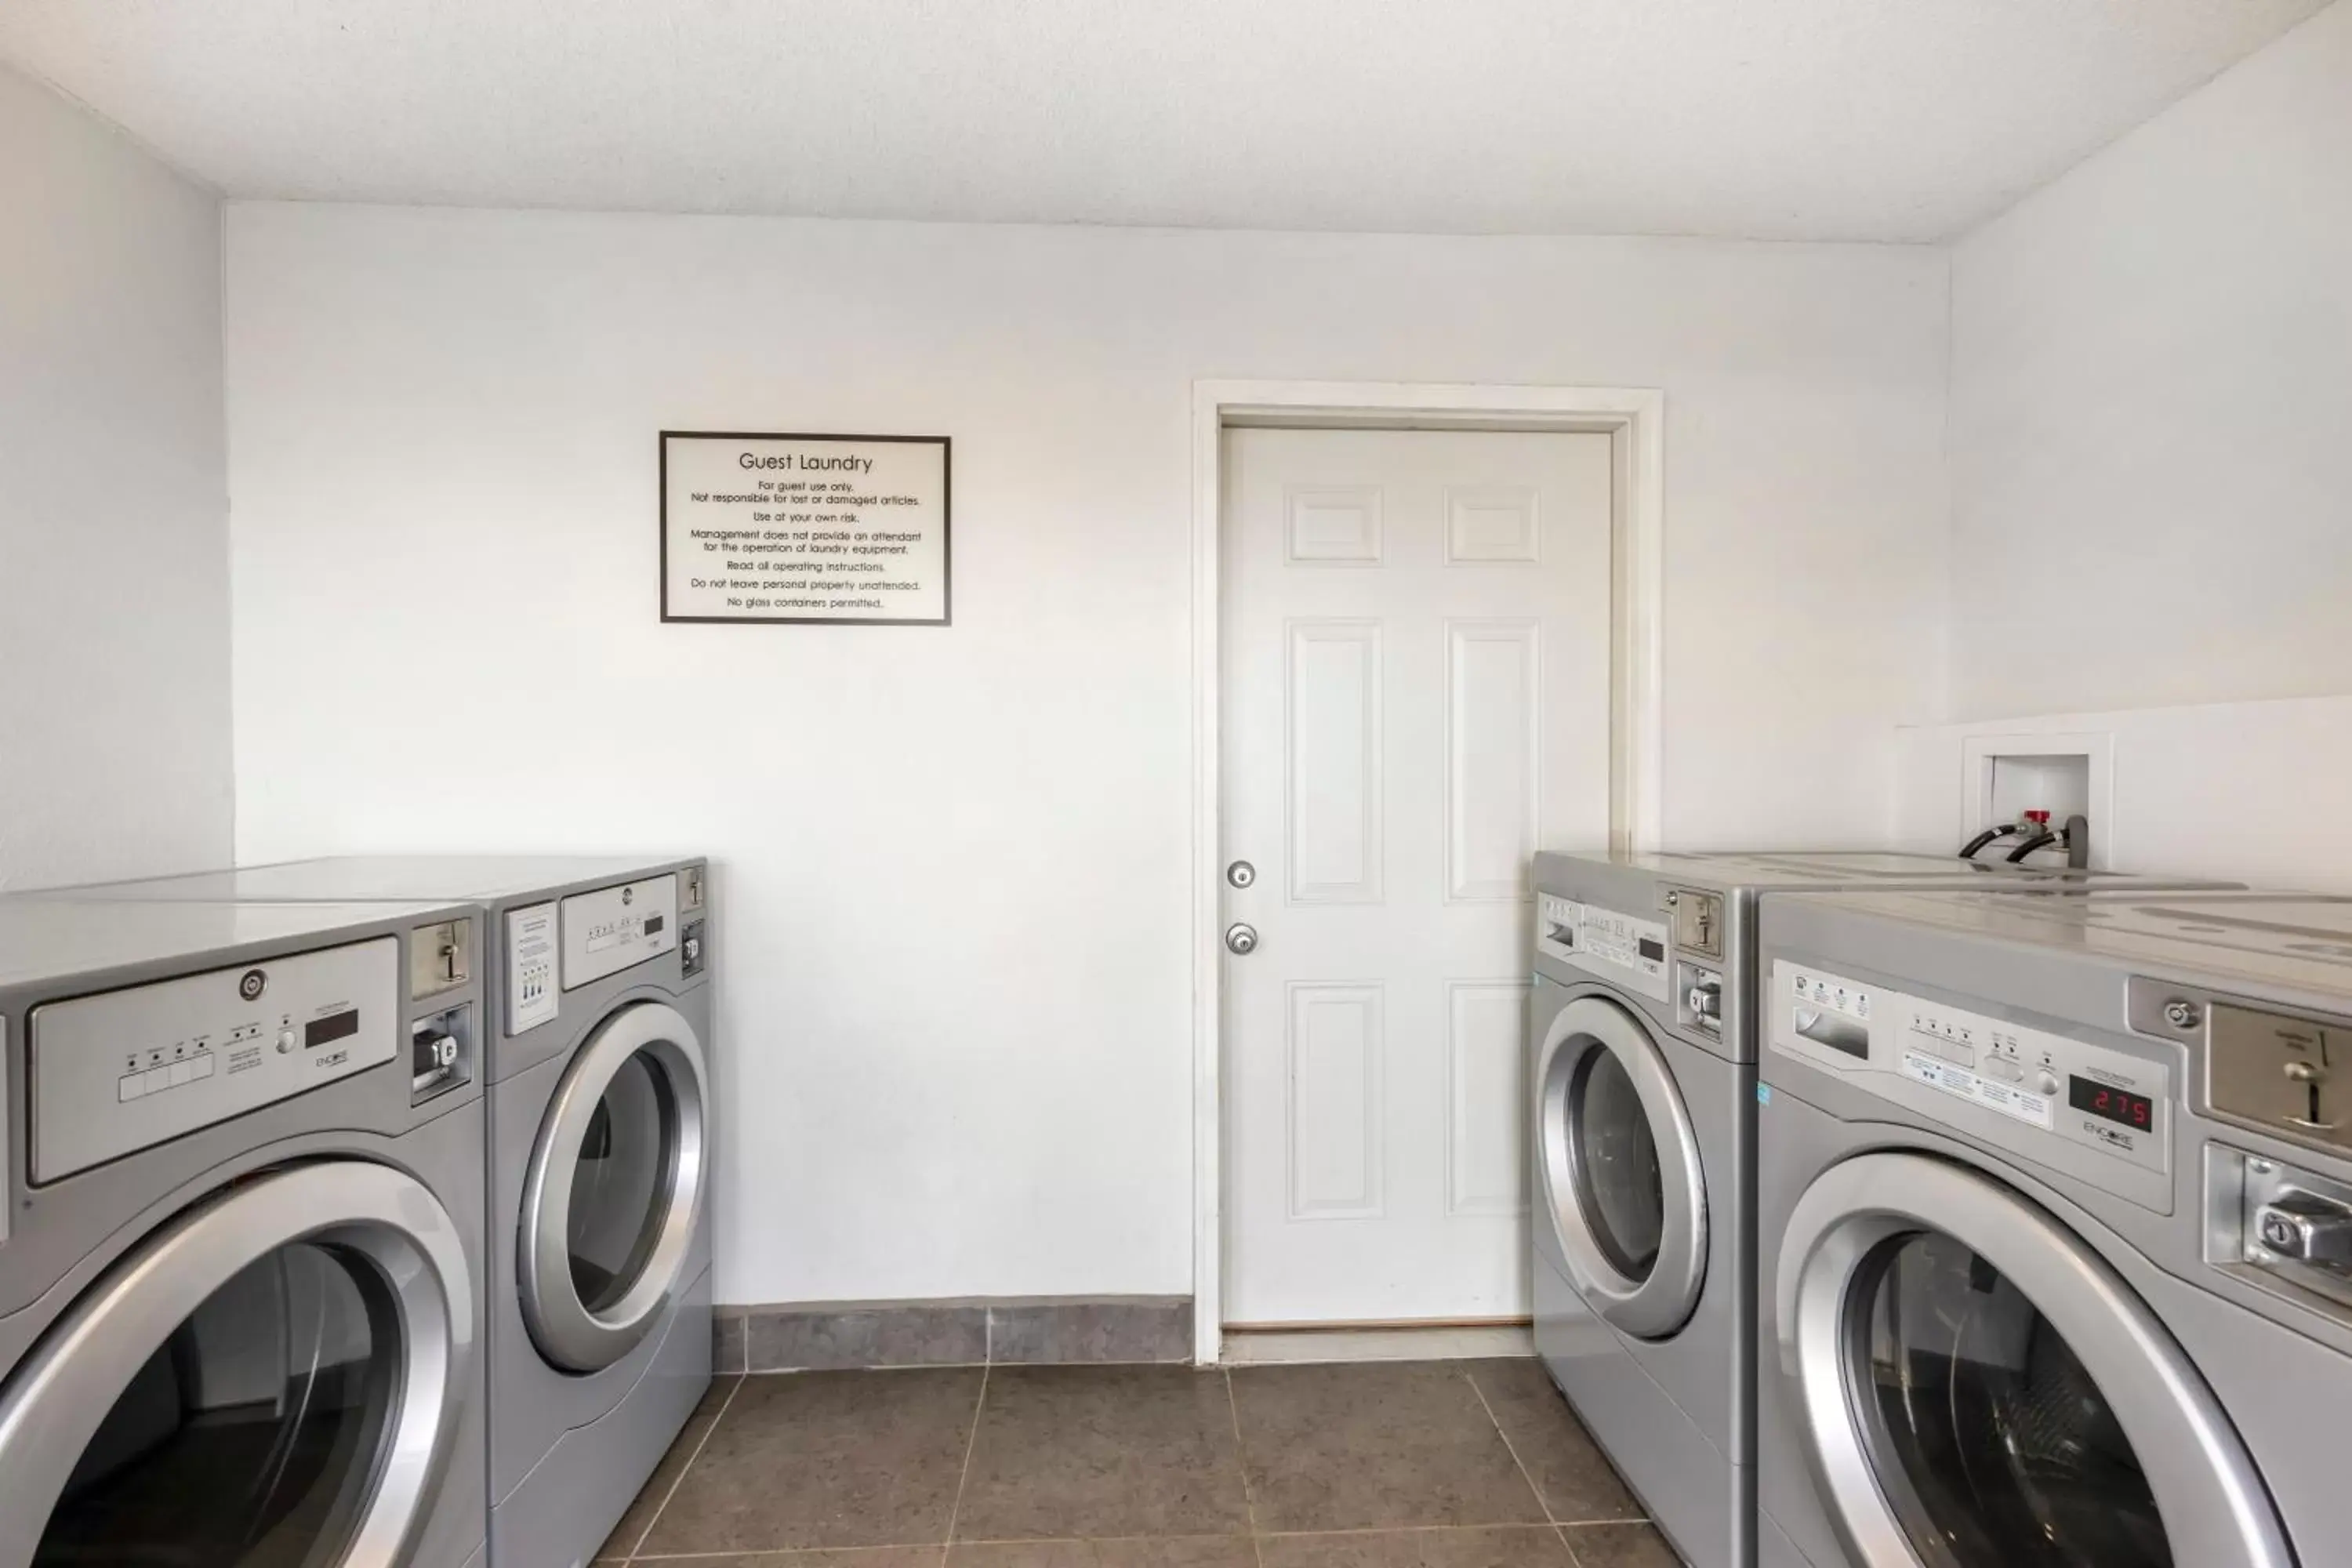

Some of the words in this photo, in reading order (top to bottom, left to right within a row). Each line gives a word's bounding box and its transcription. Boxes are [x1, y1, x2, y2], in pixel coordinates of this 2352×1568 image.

[739, 452, 792, 470] Guest
[800, 454, 873, 474] Laundry
[758, 481, 775, 490] For
[778, 481, 806, 492] guest
[831, 483, 854, 492] only.
[691, 493, 708, 502] Not
[713, 493, 769, 504] responsible
[774, 494, 786, 503] for
[790, 495, 808, 503] lost
[826, 495, 877, 506] damaged
[880, 495, 920, 506] articles.
[753, 512, 771, 521] Use
[775, 513, 786, 521] at
[789, 514, 811, 523] your
[840, 513, 859, 522] risk.
[690, 529, 760, 540] Management
[763, 531, 789, 539] does
[793, 531, 808, 539] not
[812, 532, 850, 541] provide
[872, 532, 921, 541] attendant
[704, 542, 717, 551] for
[721, 543, 738, 552] the
[742, 543, 793, 554] operation
[796, 544, 806, 553] of
[809, 543, 848, 554] laundry
[852, 545, 908, 555] equipment.
[727, 561, 753, 570] Read
[757, 561, 769, 570] all
[772, 562, 822, 572] operating
[826, 561, 885, 572] instructions.
[691, 578, 706, 587] Do
[710, 579, 727, 588] not
[730, 579, 759, 588] leave
[763, 580, 806, 590] personal
[810, 580, 855, 591] property
[858, 581, 920, 590] unattended.
[727, 597, 742, 606] No
[746, 597, 771, 608] glass
[774, 598, 826, 608] containers
[830, 599, 884, 608] permitted.
[2083, 1121, 2133, 1145] ENCORE
